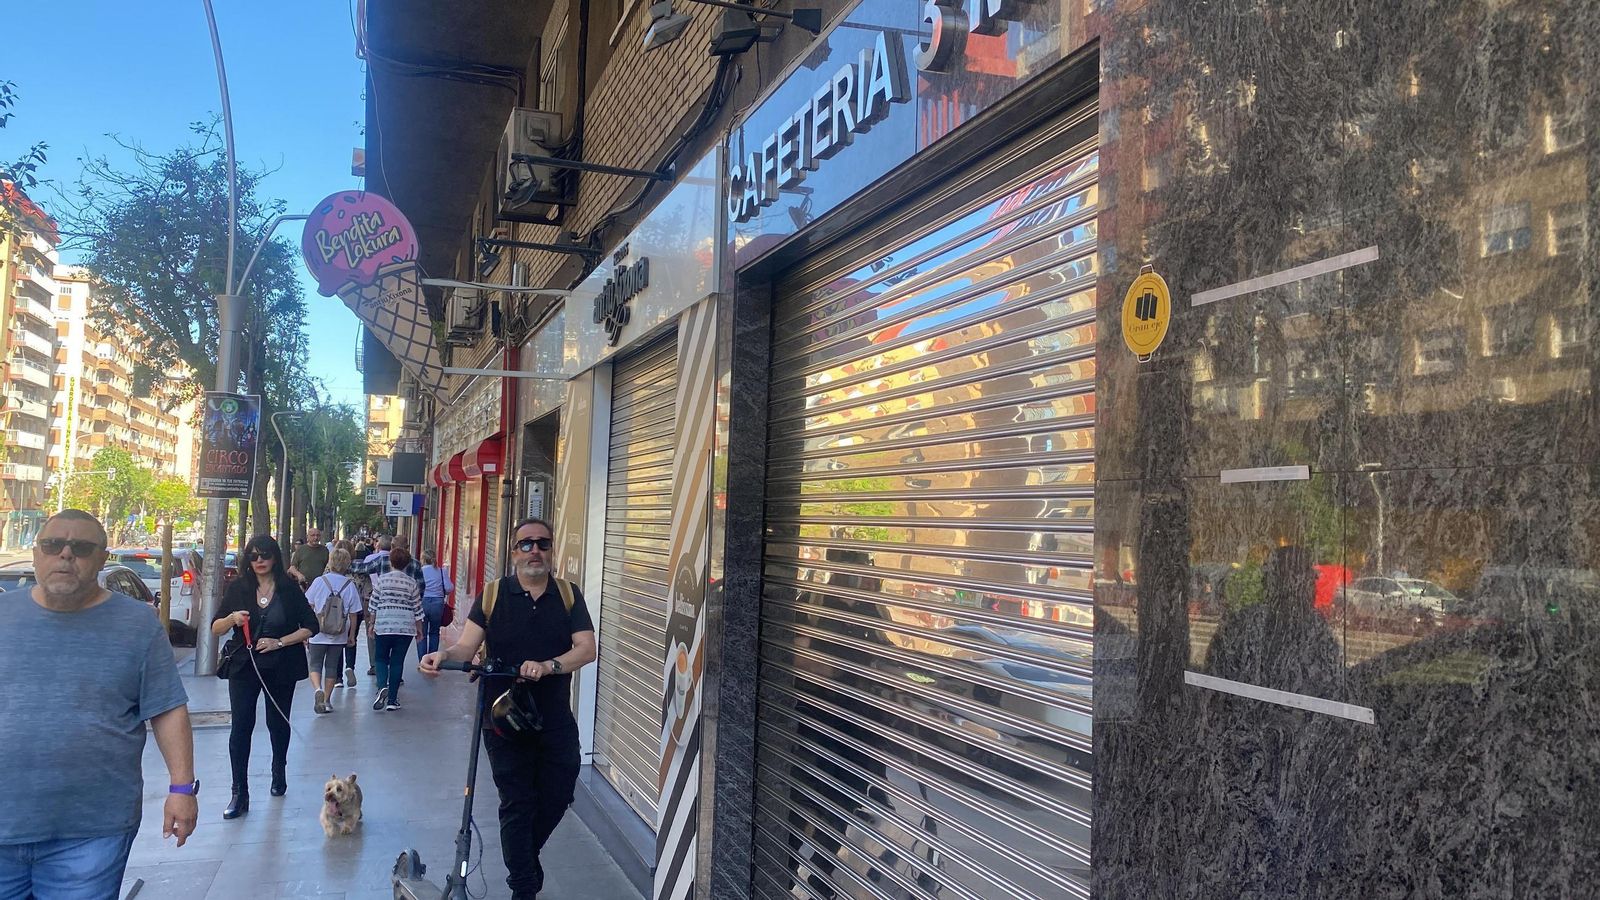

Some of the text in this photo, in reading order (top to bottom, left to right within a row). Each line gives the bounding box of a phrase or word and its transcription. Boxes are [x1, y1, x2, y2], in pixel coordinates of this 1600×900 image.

[727, 30, 904, 223] CAFETERIA
[314, 211, 386, 264] Bendita
[343, 225, 404, 268] Lokura
[206, 449, 249, 465] CIRCO
